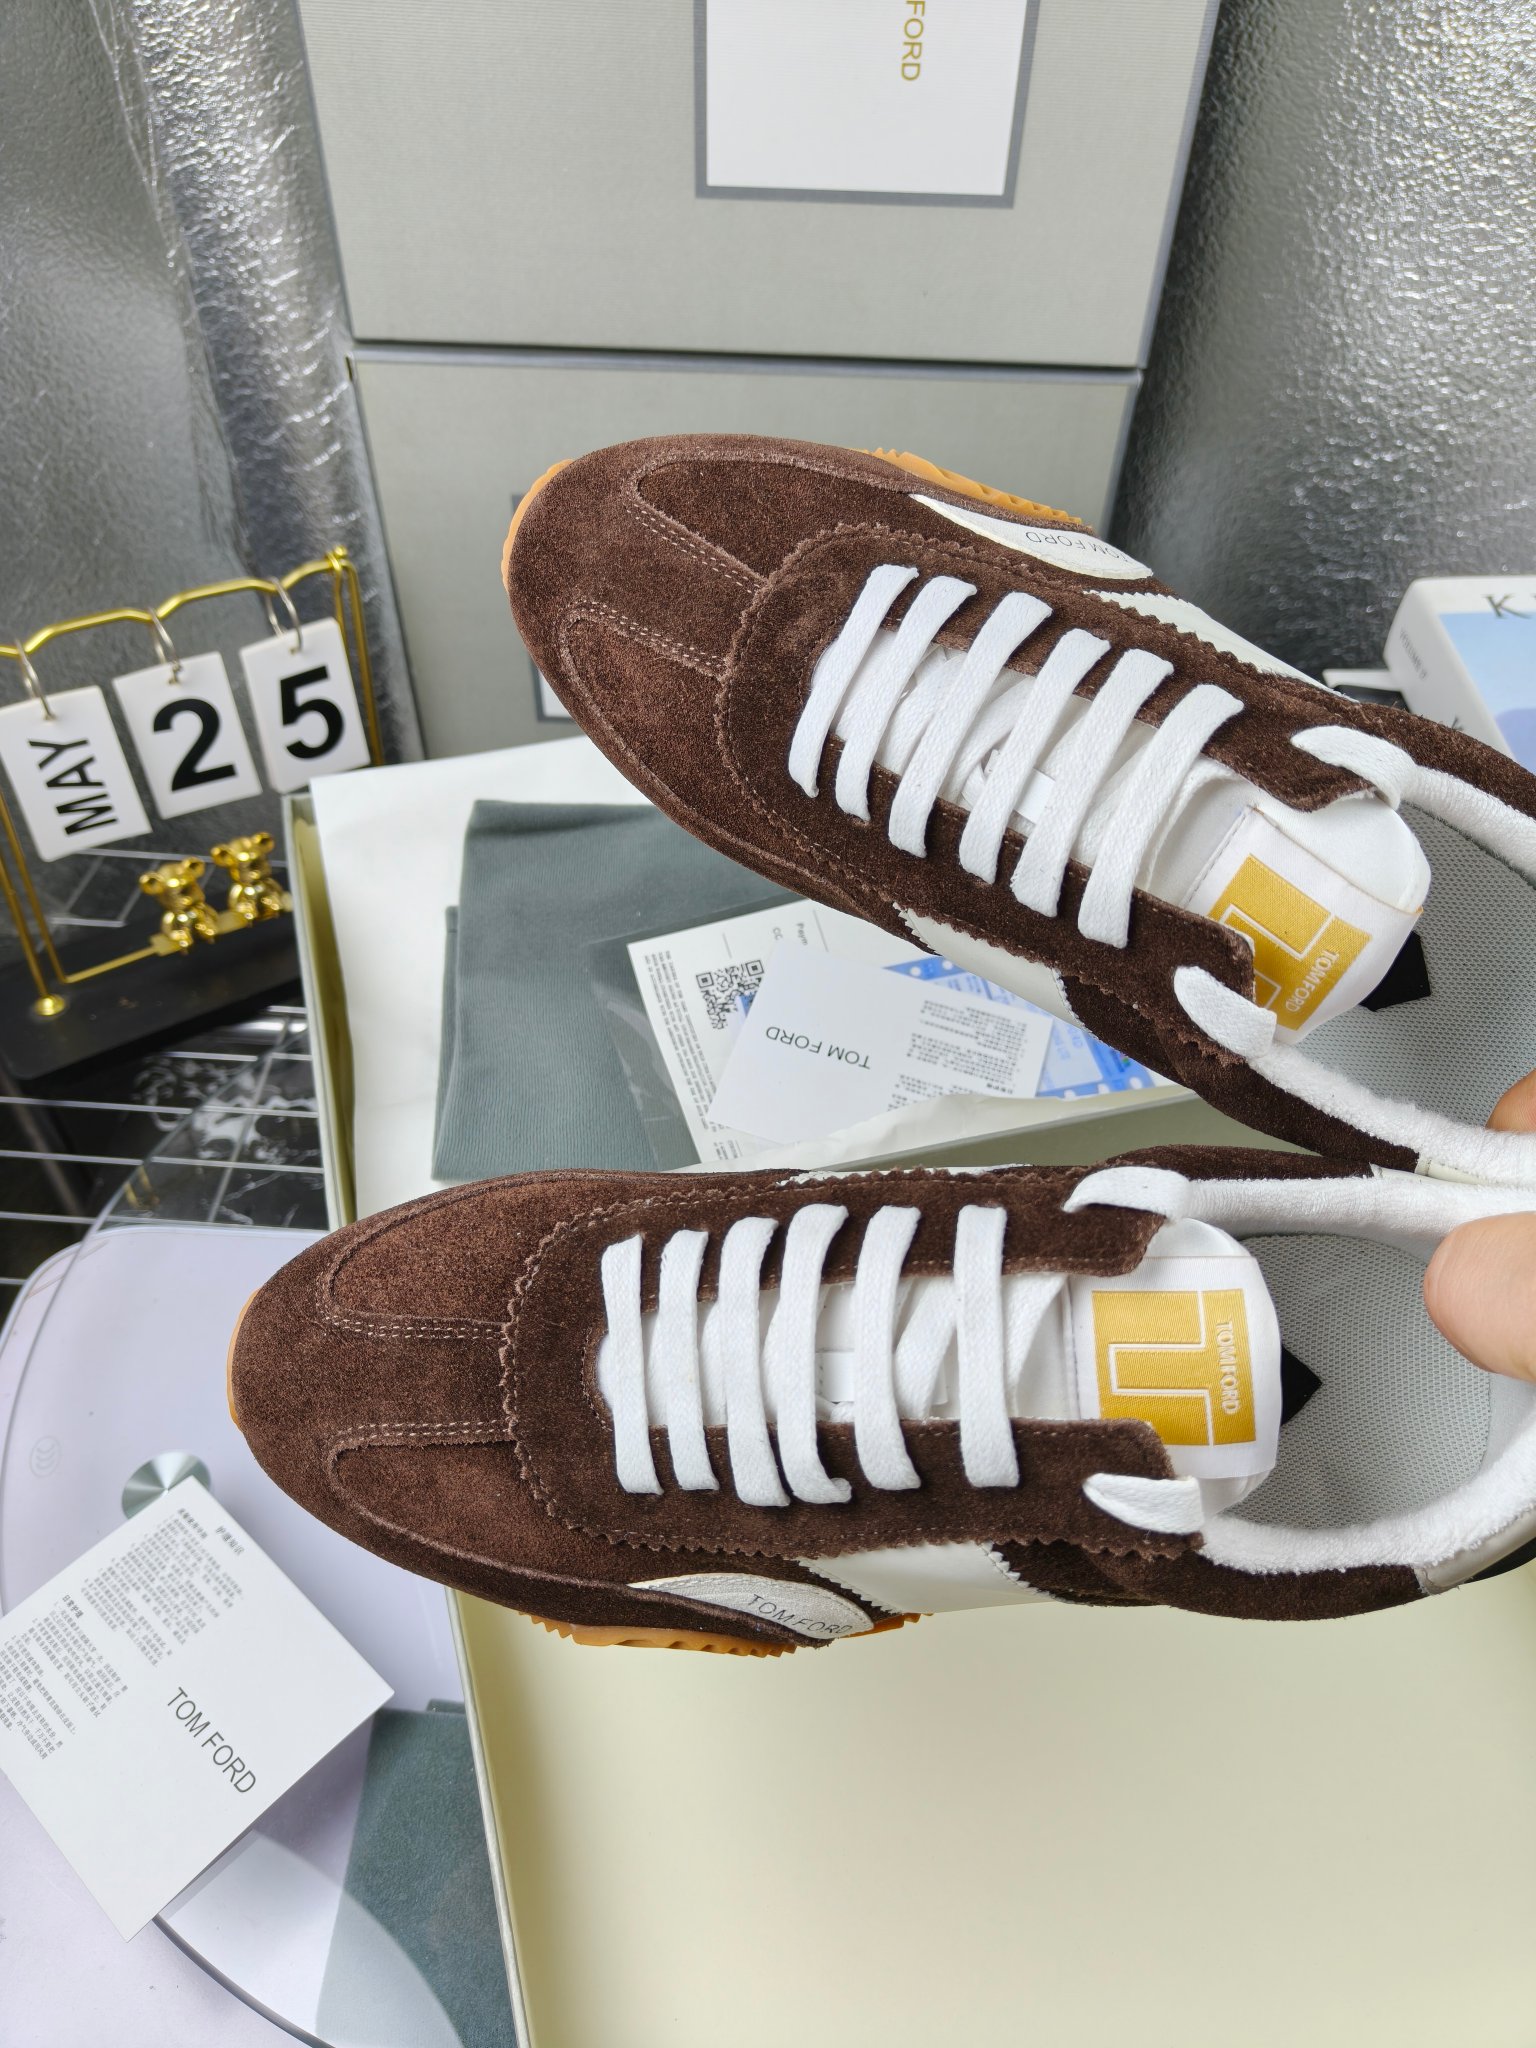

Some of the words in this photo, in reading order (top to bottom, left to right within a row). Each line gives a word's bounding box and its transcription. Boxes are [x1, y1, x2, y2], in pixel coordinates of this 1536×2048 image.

[901, 0, 926, 81] FORD
[1026, 531, 1086, 550] FORD
[29, 738, 119, 836] MAY
[153, 698, 236, 791] 2
[279, 665, 345, 760] 5
[765, 1026, 822, 1054] FORD
[827, 1044, 870, 1070] TOM
[748, 1593, 795, 1623] TOM
[792, 1618, 853, 1634] FORD
[167, 1686, 211, 1738] TOM
[201, 1731, 257, 1793] FORD
